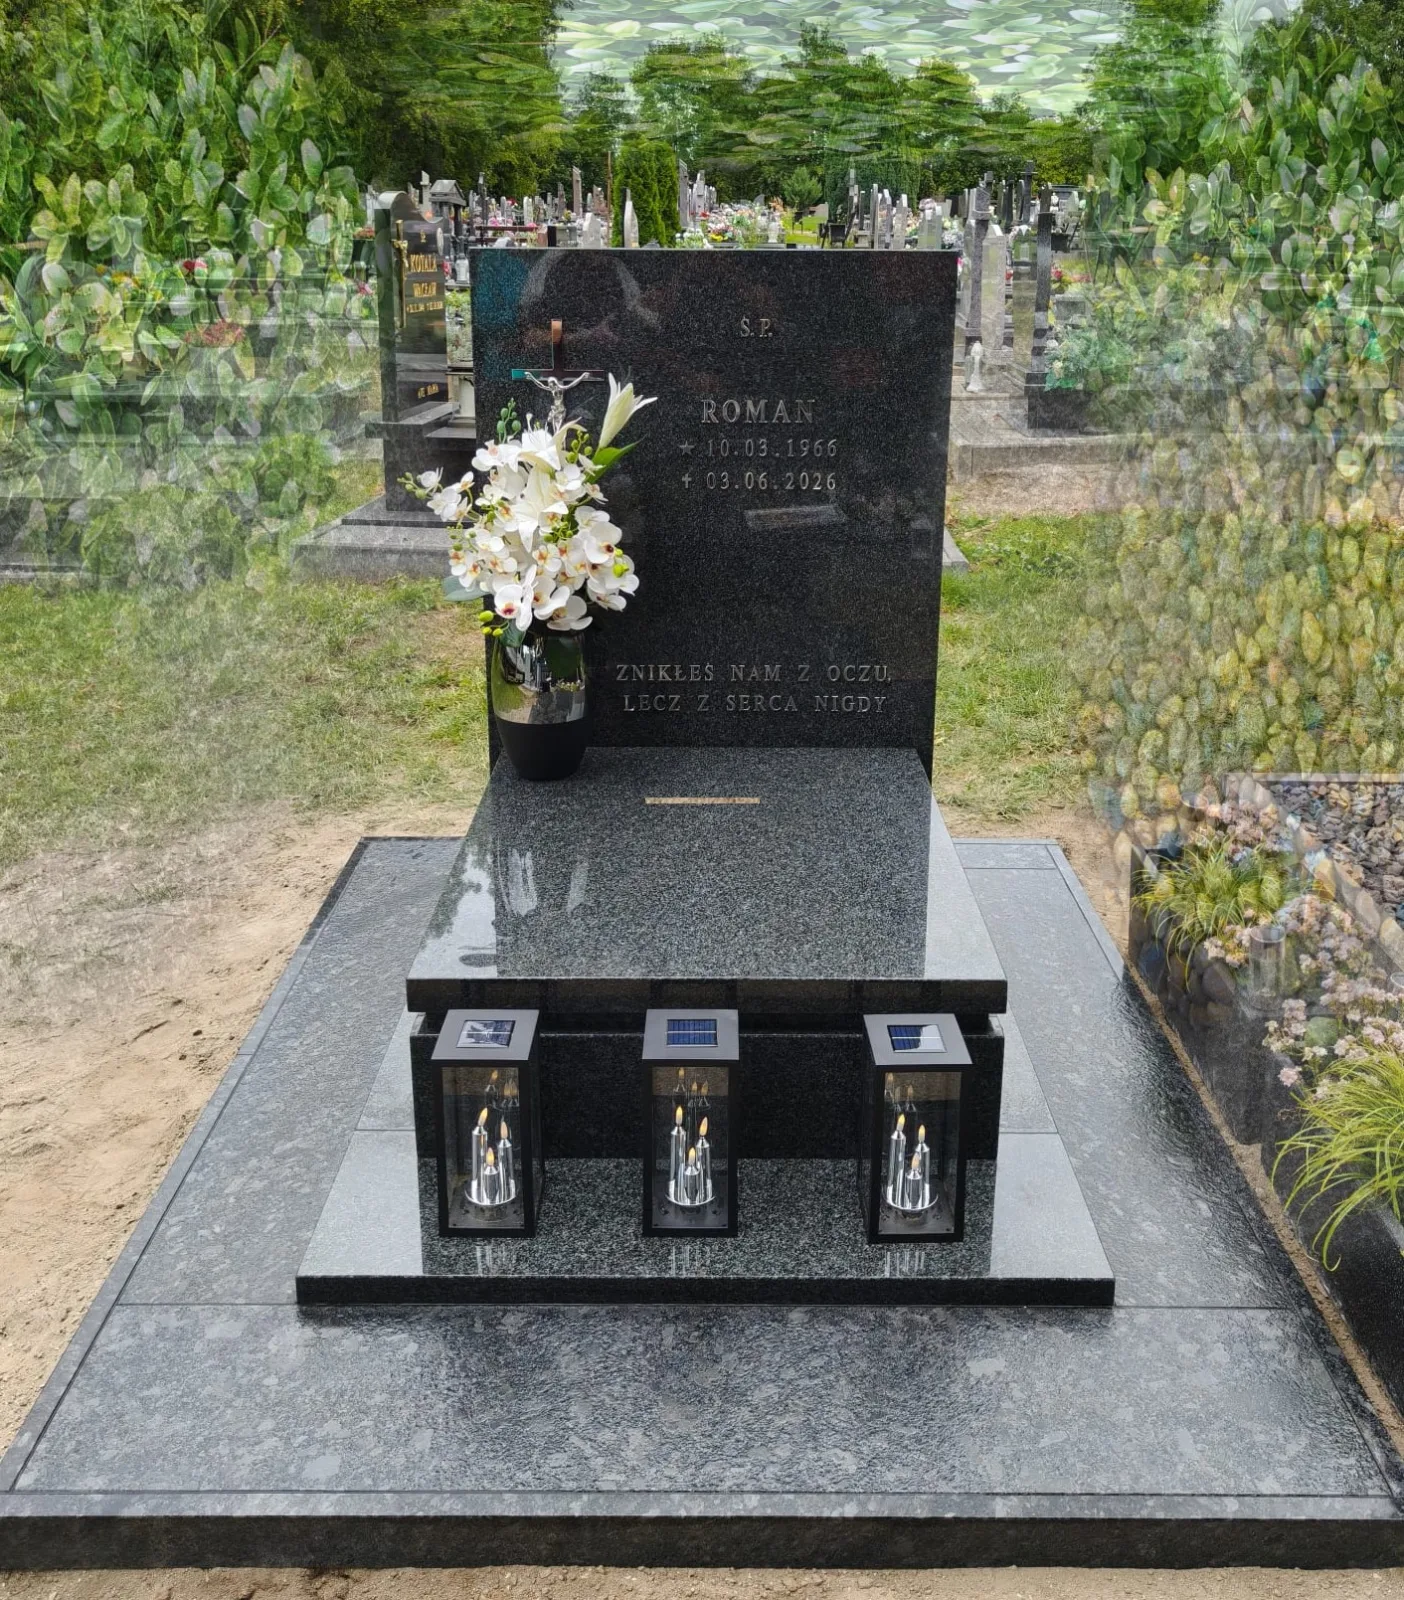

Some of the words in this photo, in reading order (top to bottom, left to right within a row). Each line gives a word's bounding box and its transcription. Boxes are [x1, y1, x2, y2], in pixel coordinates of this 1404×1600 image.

[700, 399, 816, 424] ROMAN
[706, 438, 838, 457] 10.03.1966
[705, 471, 837, 490] 03.06.2026
[616, 662, 715, 682] ZNIKŁEŚ
[730, 664, 782, 682] NAM
[797, 664, 811, 682] Z
[623, 695, 681, 712] LECZ
[696, 695, 710, 712] Z
[725, 695, 799, 712] SERCA
[814, 695, 887, 713] NIGDY
